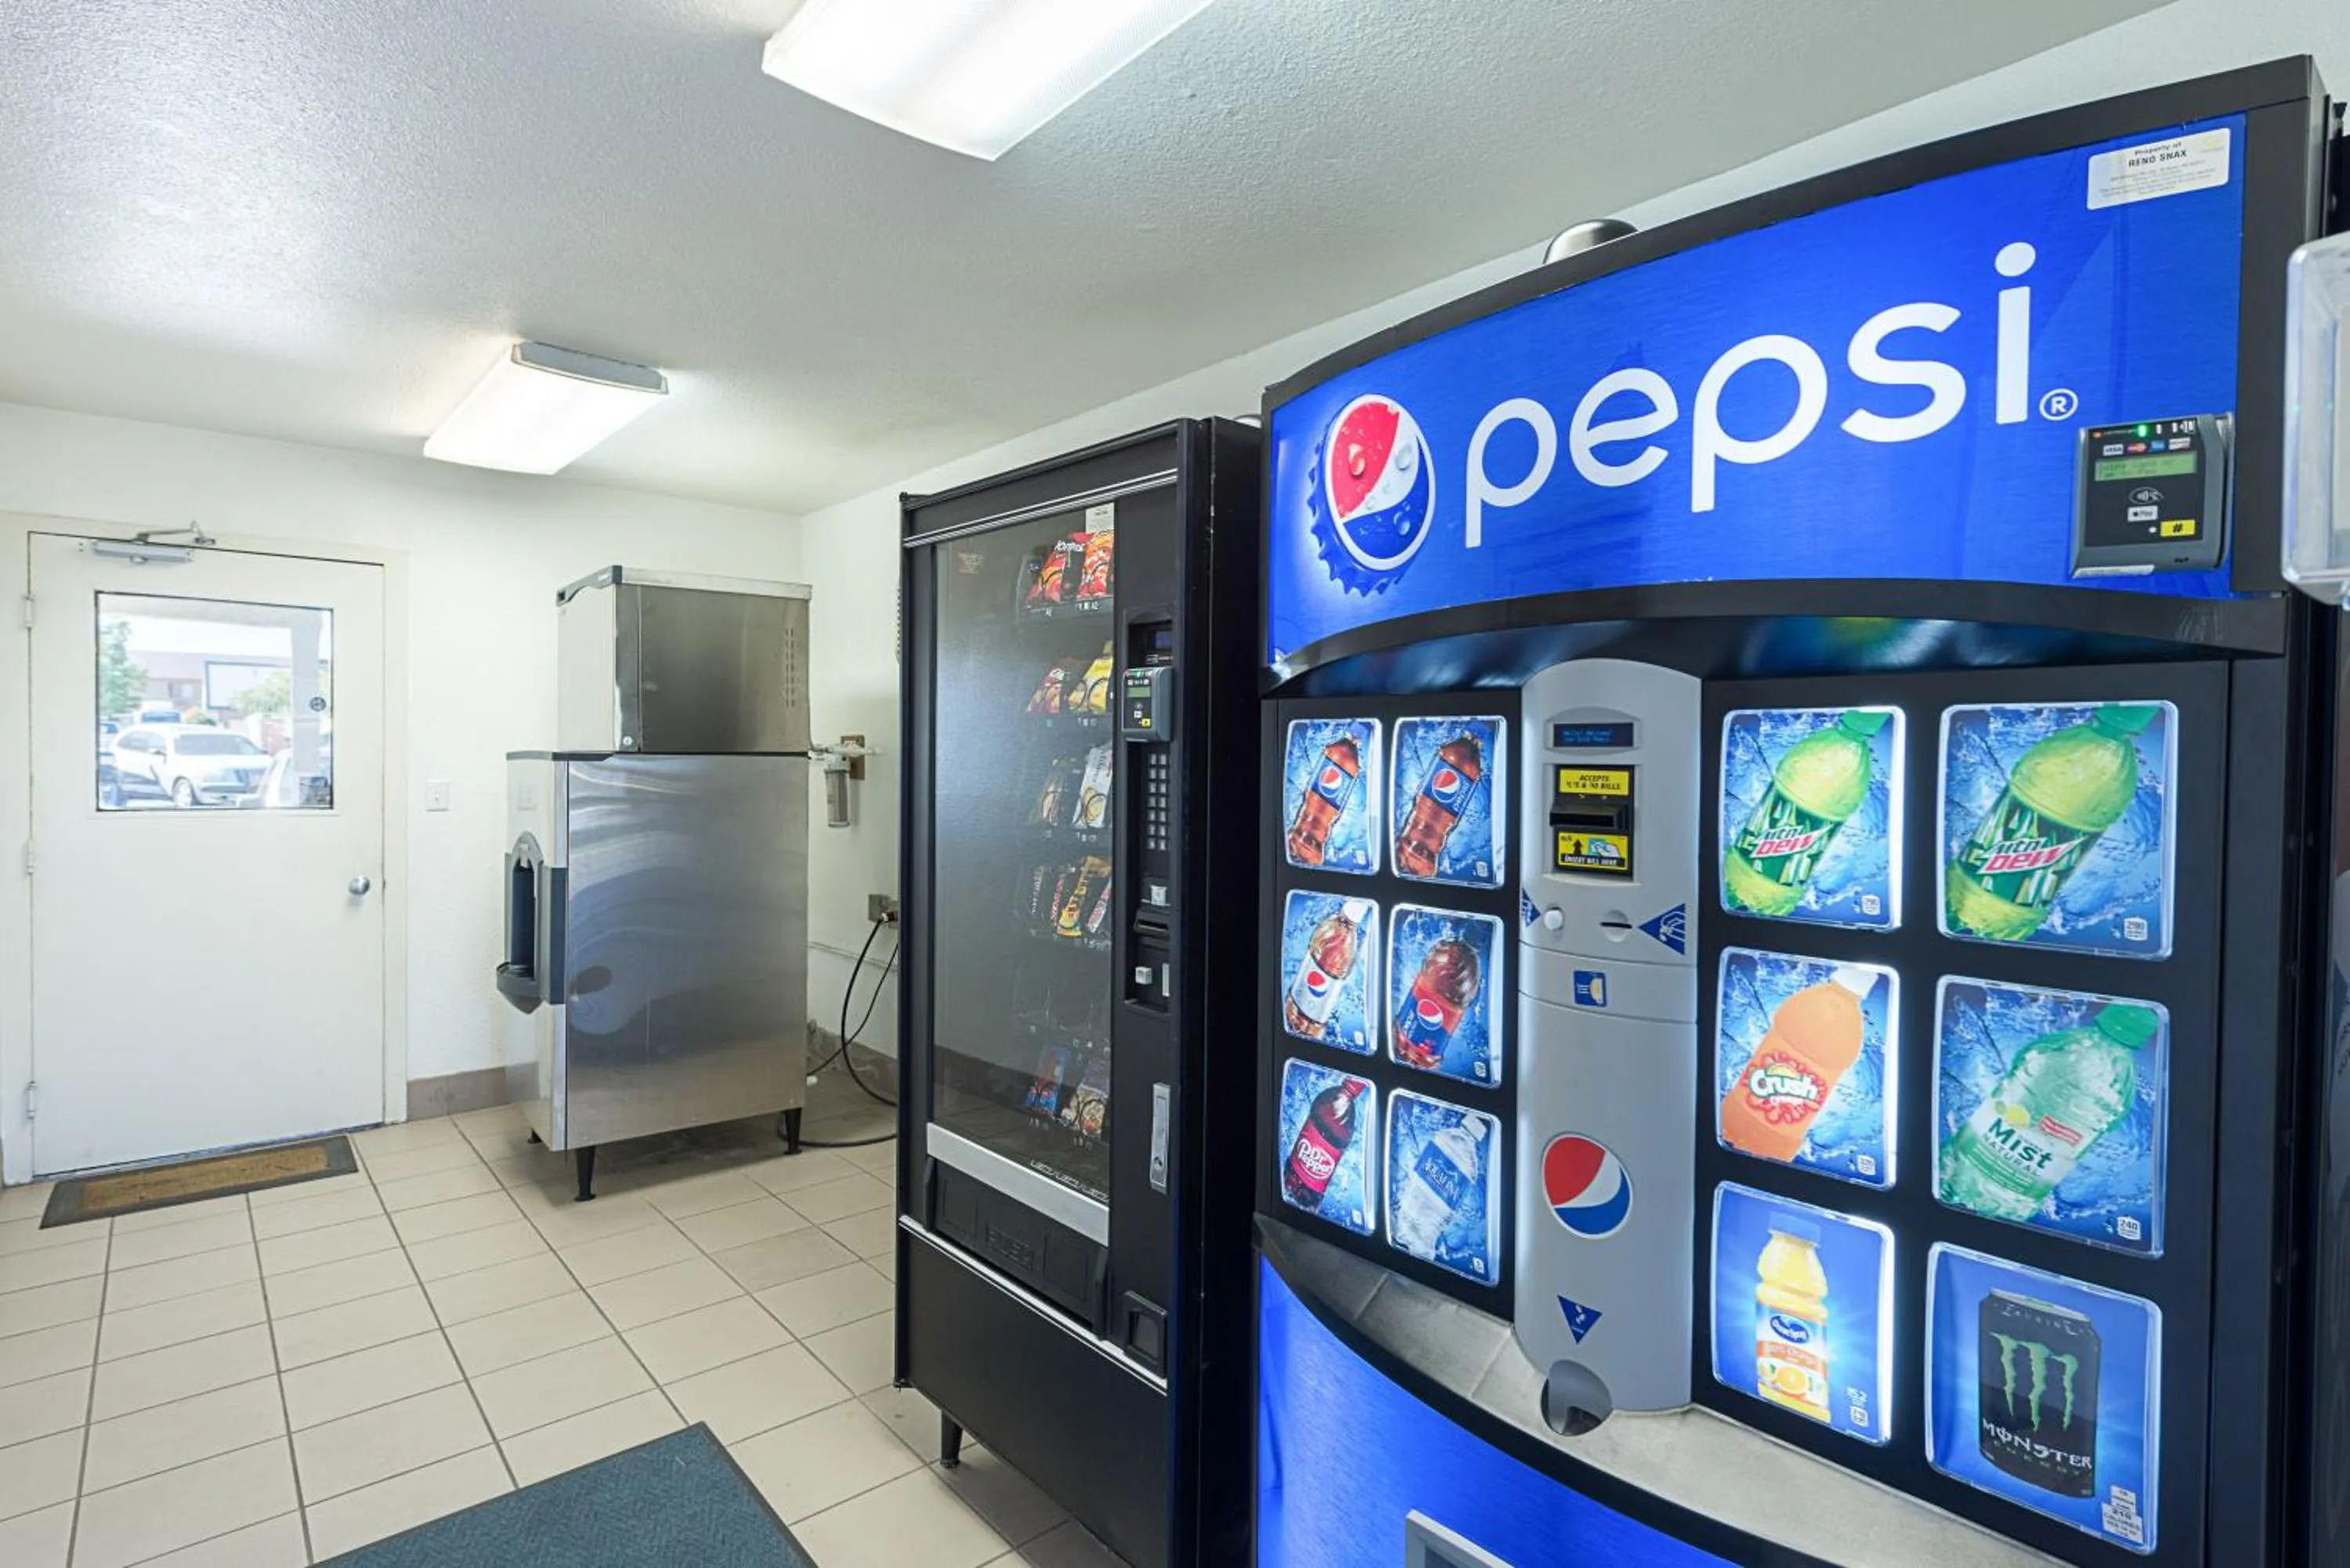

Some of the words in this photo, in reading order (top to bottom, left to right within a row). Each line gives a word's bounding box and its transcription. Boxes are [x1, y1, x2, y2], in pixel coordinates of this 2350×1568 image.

[2128, 154, 2157, 168] RENO
[2159, 149, 2188, 162] SNAX
[1465, 241, 2037, 548] pepsi
